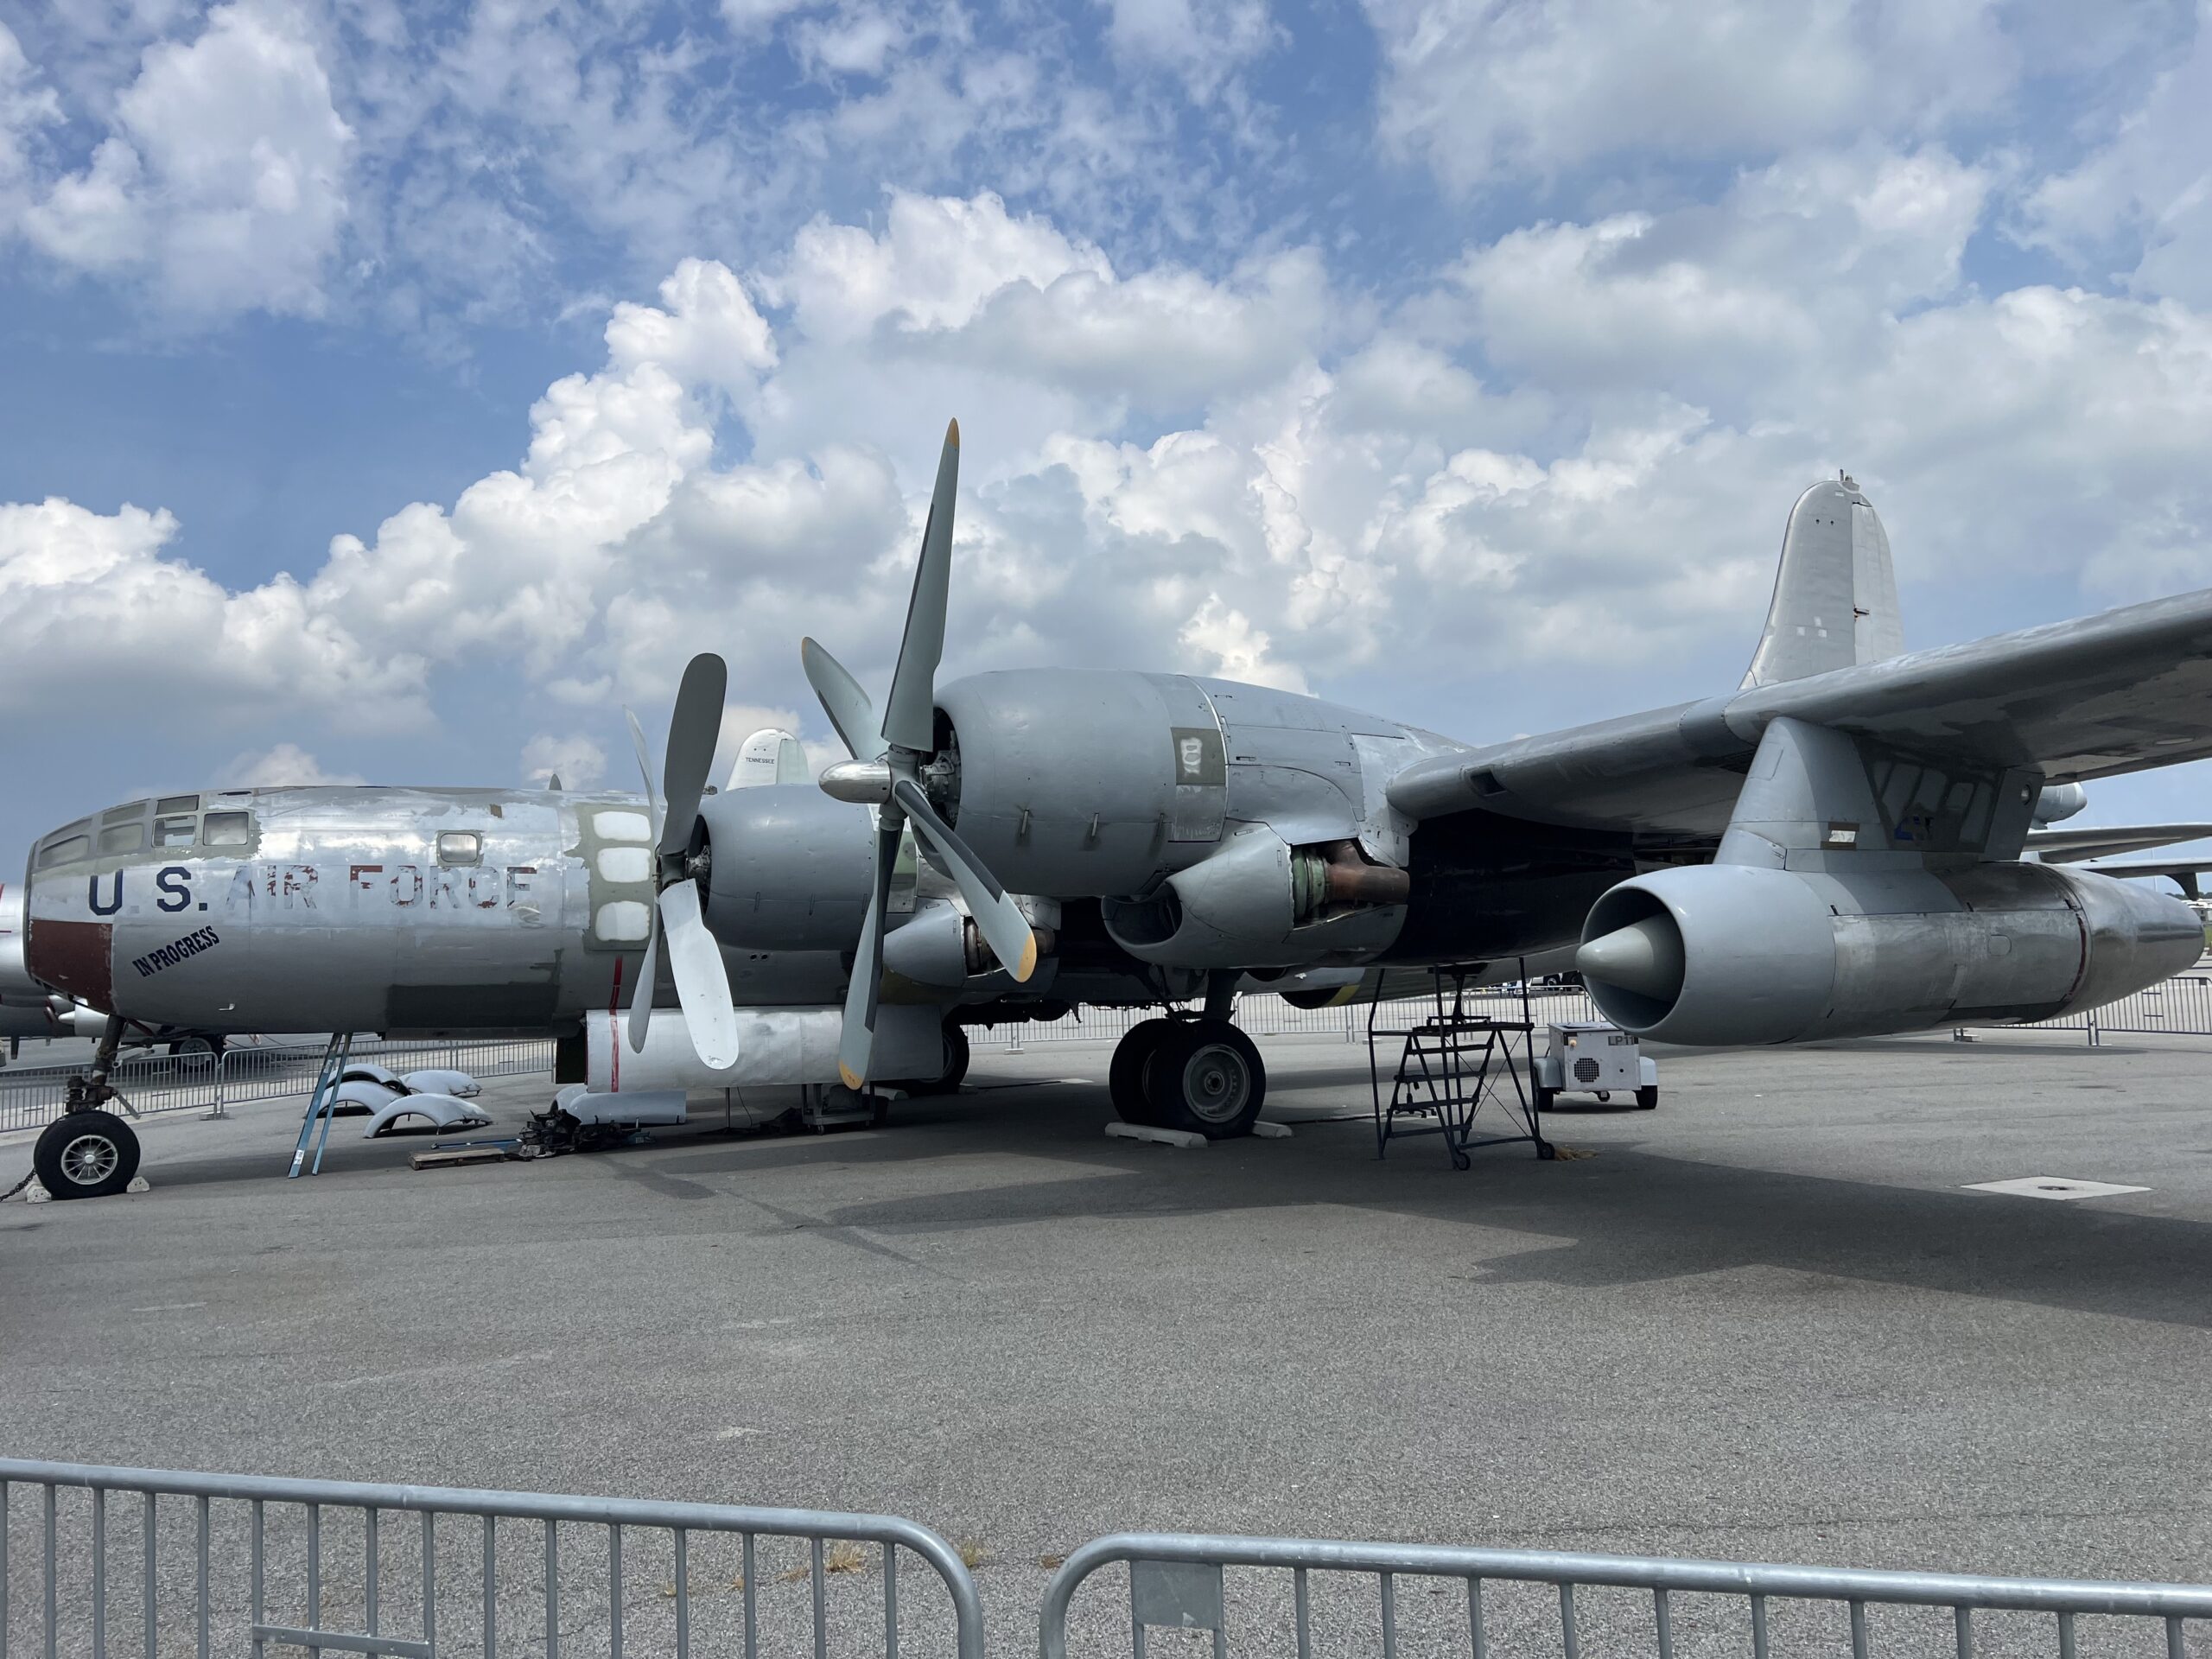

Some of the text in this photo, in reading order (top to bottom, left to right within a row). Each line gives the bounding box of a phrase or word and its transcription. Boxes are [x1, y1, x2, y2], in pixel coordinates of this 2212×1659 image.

[226, 864, 319, 910] AIR
[349, 864, 537, 909] FORCE
[132, 925, 220, 977] IN PROGRESS
